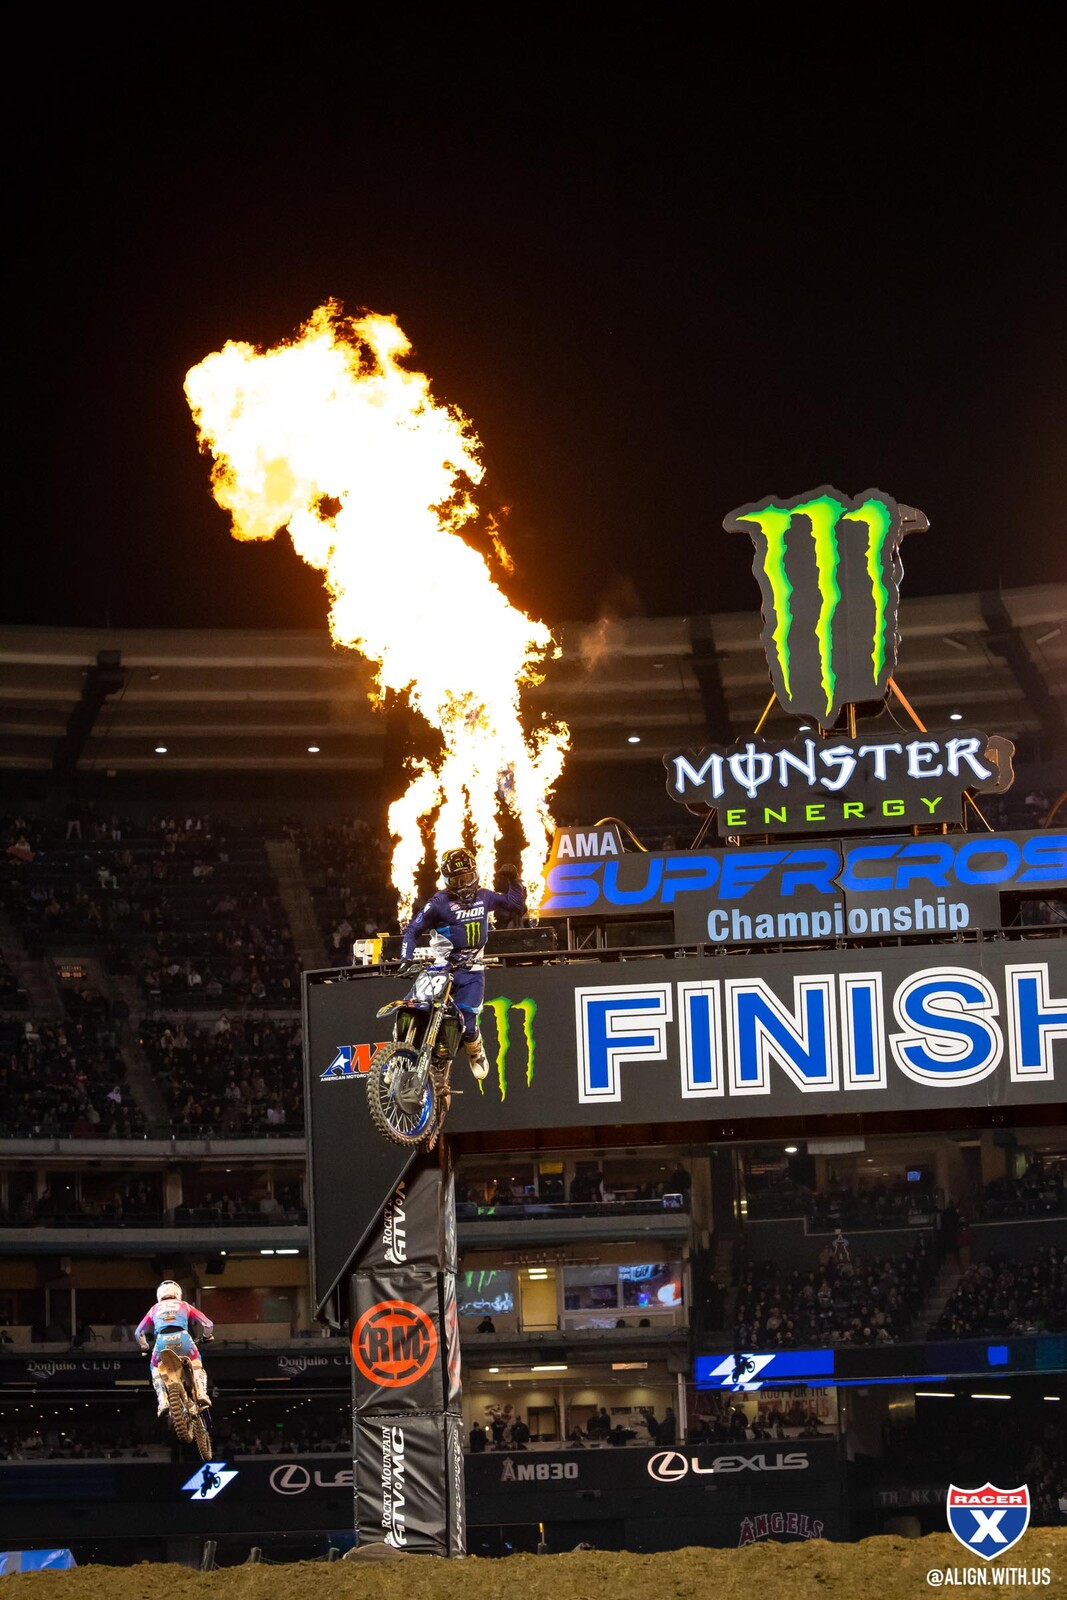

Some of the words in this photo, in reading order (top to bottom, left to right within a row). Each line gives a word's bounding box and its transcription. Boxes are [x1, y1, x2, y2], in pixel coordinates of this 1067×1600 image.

[672, 737, 992, 798] MONSTER
[726, 796, 943, 826] ENERGY
[557, 832, 619, 858] AMA
[455, 906, 485, 920] THOR
[707, 897, 970, 942] Championship
[368, 1325, 422, 1362] RM
[82, 1360, 121, 1370] CLUB
[333, 1356, 352, 1366] CL
[382, 1426, 392, 1489] MOUNTAIN
[692, 1453, 809, 1474] LEXUS
[382, 1492, 392, 1529] ROCKY
[738, 1512, 824, 1548] ANGELS
